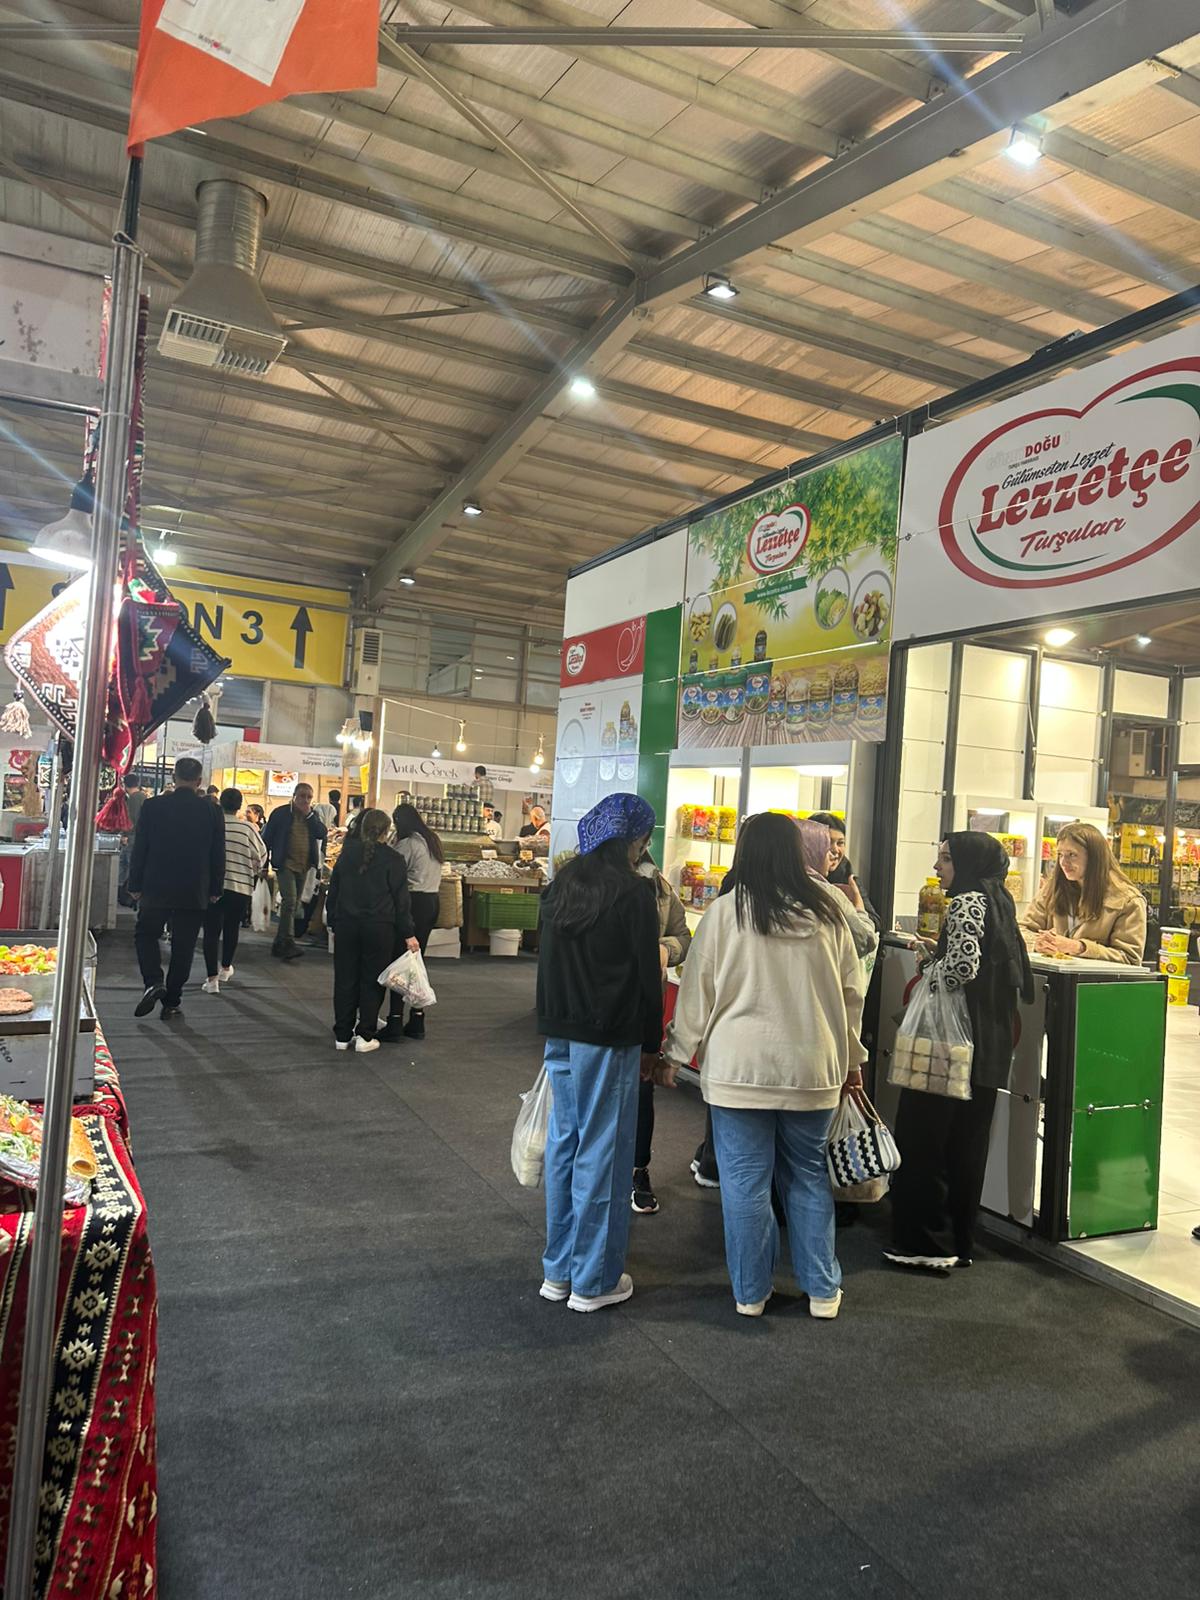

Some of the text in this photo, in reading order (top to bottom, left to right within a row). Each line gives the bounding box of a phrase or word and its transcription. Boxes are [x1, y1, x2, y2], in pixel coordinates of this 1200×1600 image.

[1025, 435, 1061, 458] DOĞU
[1002, 442, 1116, 490] Gülümseten Lezzet
[976, 438, 1193, 535] Lezzetçe
[756, 527, 800, 554] Lezzetçe
[1020, 517, 1127, 558] Turşuları
[240, 610, 264, 645] 3
